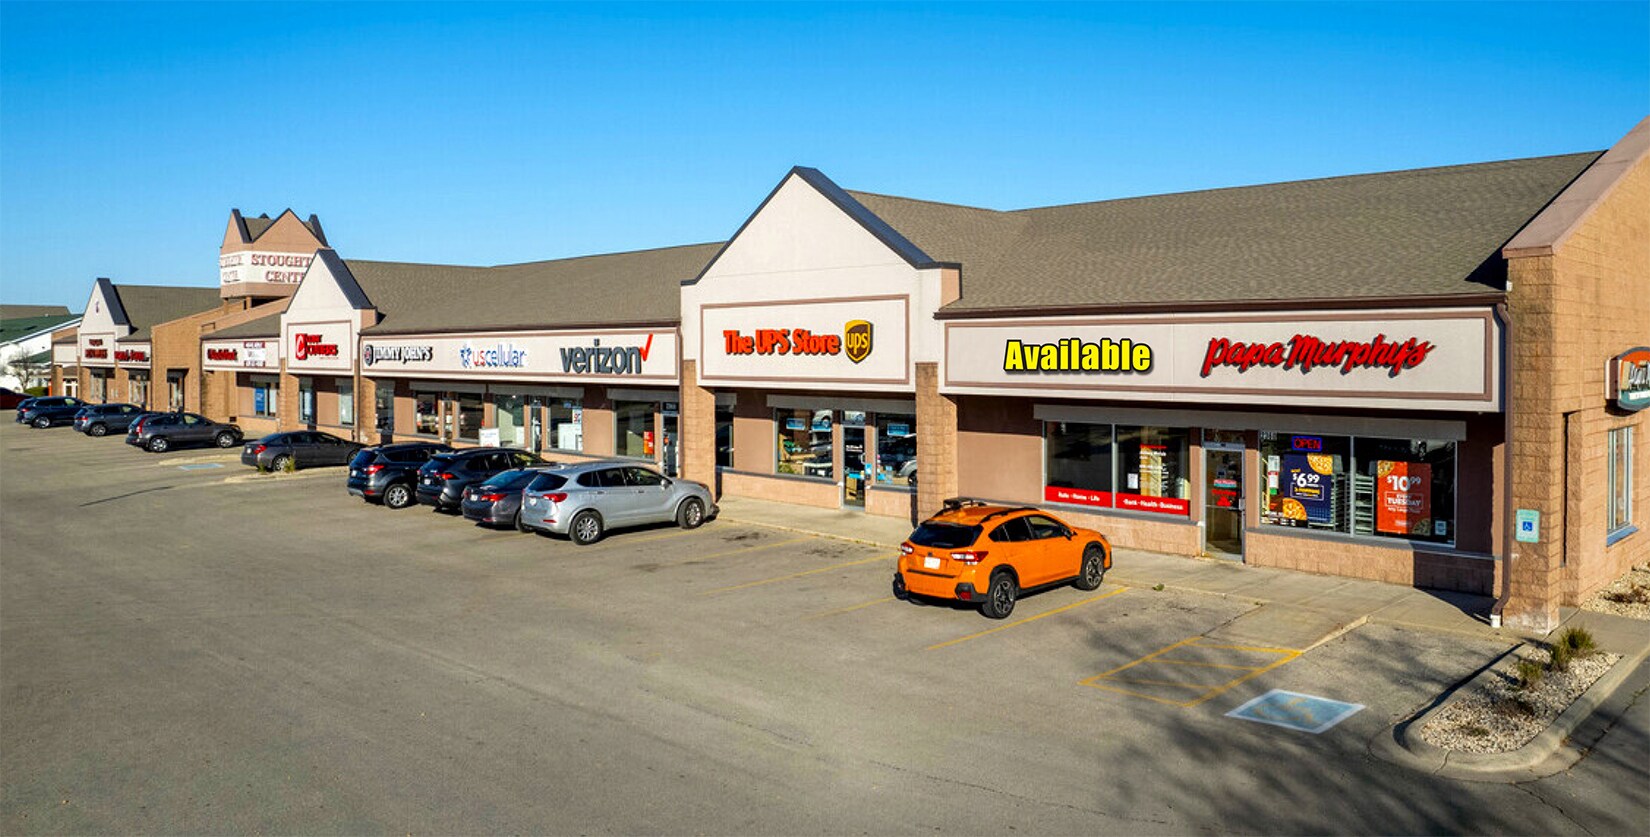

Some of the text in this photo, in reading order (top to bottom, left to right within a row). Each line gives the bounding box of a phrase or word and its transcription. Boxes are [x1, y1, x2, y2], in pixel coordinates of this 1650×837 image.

[251, 254, 311, 267] STOUGHT
[265, 270, 305, 283] CENT
[723, 329, 841, 355] The UPS Store
[373, 347, 402, 363] JIMMY
[402, 347, 433, 364] JOHN'S
[560, 338, 642, 374] verizon
[1293, 437, 1321, 449] OPEN
